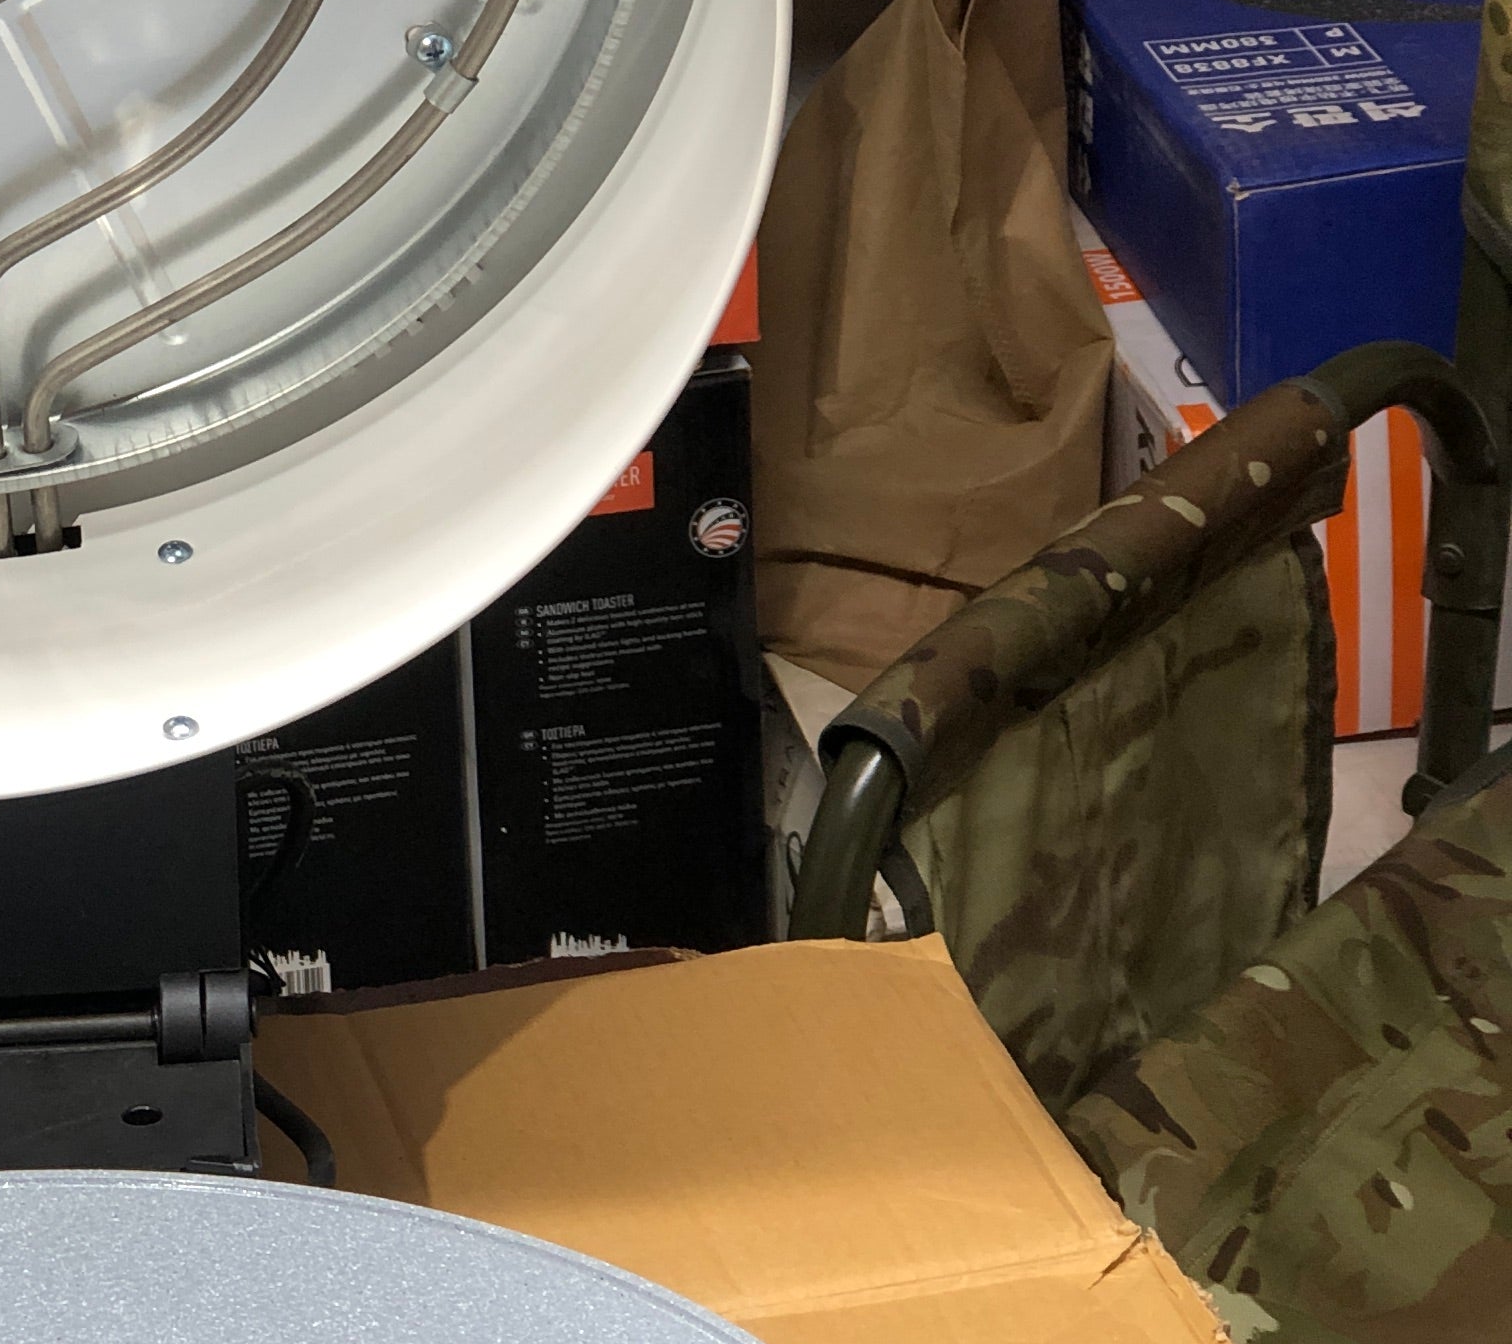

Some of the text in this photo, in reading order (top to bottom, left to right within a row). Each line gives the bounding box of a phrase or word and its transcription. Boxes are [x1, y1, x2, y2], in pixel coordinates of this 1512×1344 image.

[1159, 35, 1279, 56] 380MM
[1084, 252, 1137, 300] 1500W
[536, 593, 636, 618] SANDWICH TOASTER
